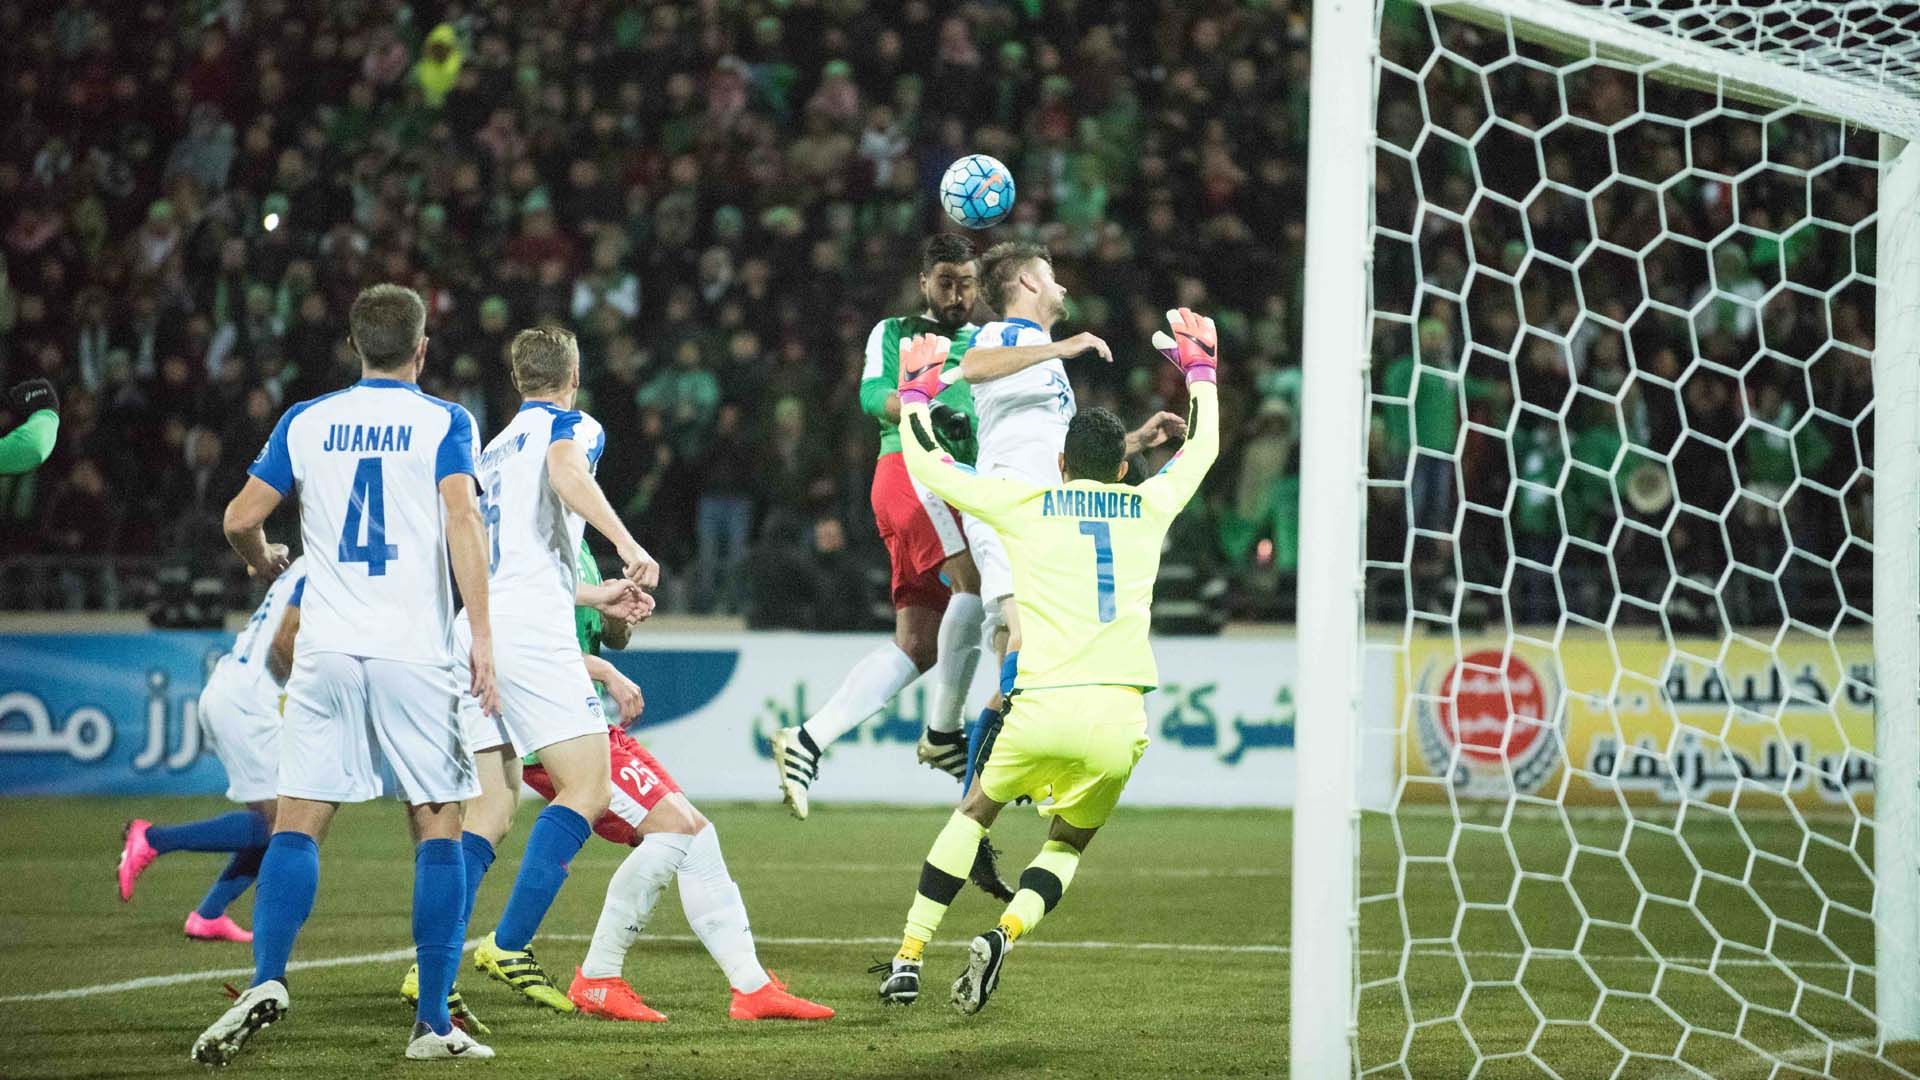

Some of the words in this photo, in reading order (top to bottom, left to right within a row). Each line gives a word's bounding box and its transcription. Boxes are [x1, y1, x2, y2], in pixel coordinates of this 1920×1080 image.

[323, 424, 412, 452] JUANAN
[338, 457, 398, 577] 4
[1043, 490, 1142, 518] AMRINDER
[1079, 521, 1117, 624] 1
[620, 759, 660, 796] 25
